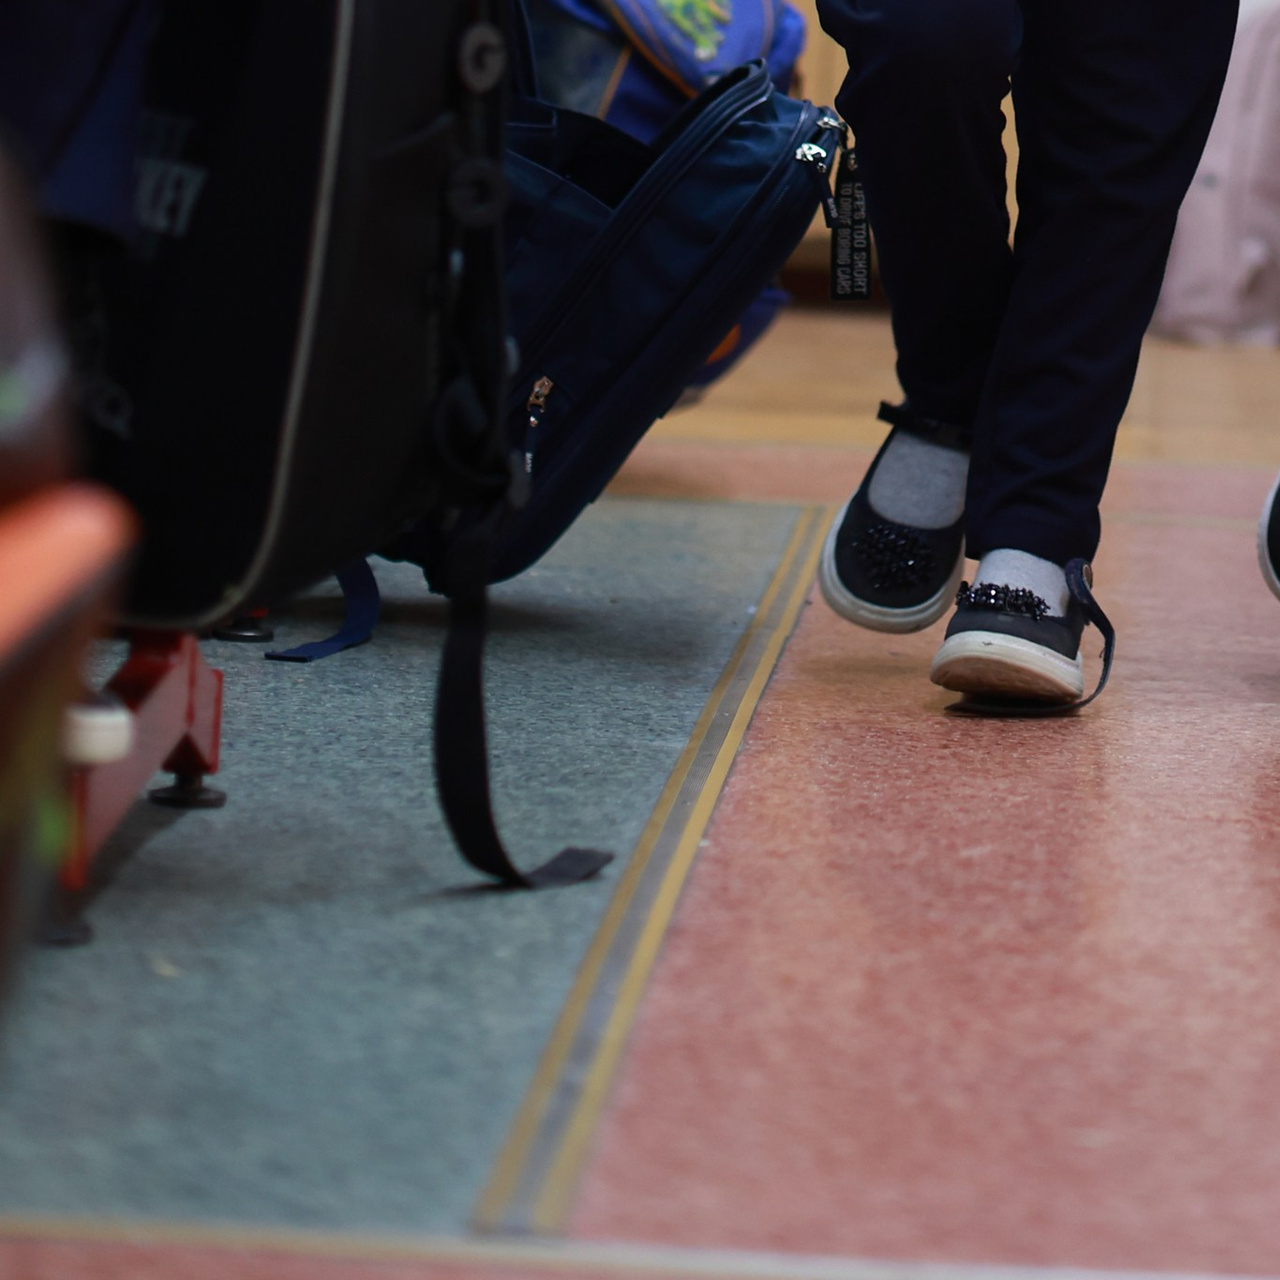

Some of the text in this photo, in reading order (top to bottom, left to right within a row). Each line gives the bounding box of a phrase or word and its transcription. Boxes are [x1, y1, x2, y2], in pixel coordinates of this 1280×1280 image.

[840, 183, 852, 196] TO
[853, 223, 867, 248] TOO
[836, 267, 852, 295] CARS
[853, 252, 868, 295] SHORT
